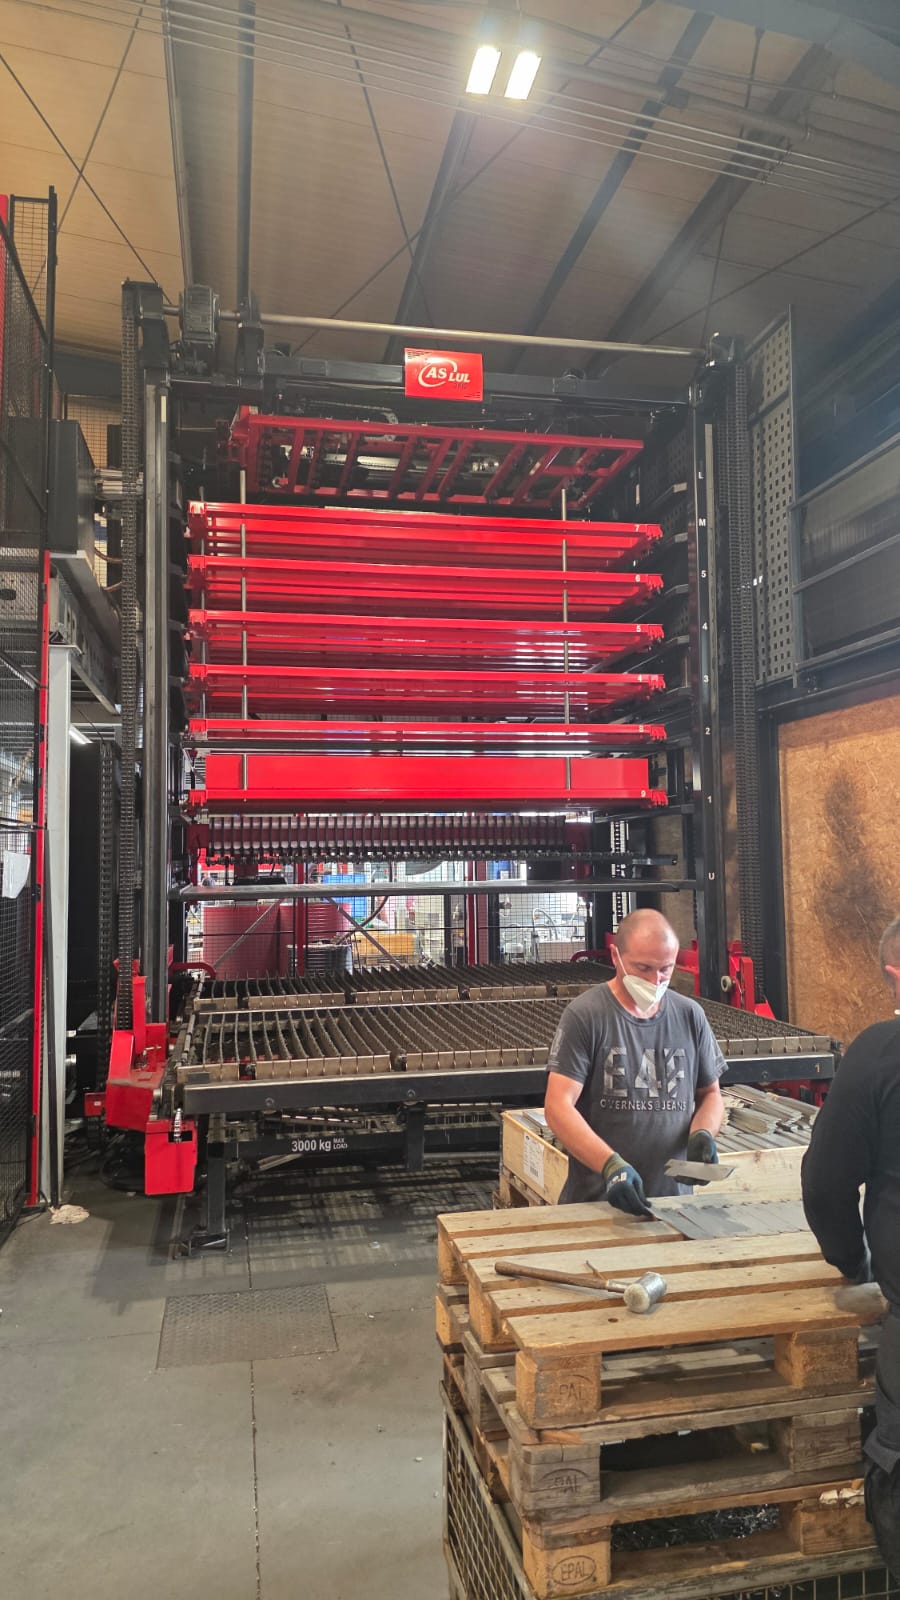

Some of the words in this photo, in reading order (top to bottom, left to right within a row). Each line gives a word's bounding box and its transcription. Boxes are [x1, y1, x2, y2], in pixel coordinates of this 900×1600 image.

[698, 471, 704, 480] L
[698, 518, 706, 527] M
[634, 524, 640, 532] 7
[700, 570, 707, 578] 5
[702, 622, 708, 631] 4
[703, 675, 709, 683] 3
[705, 727, 711, 735] 2
[707, 796, 712, 804] 1
[708, 872, 715, 881] U
[662, 1100, 687, 1110] JEANS
[291, 1138, 317, 1151] 3000
[319, 1139, 331, 1151] kg
[560, 1561, 591, 1581] EPAL
